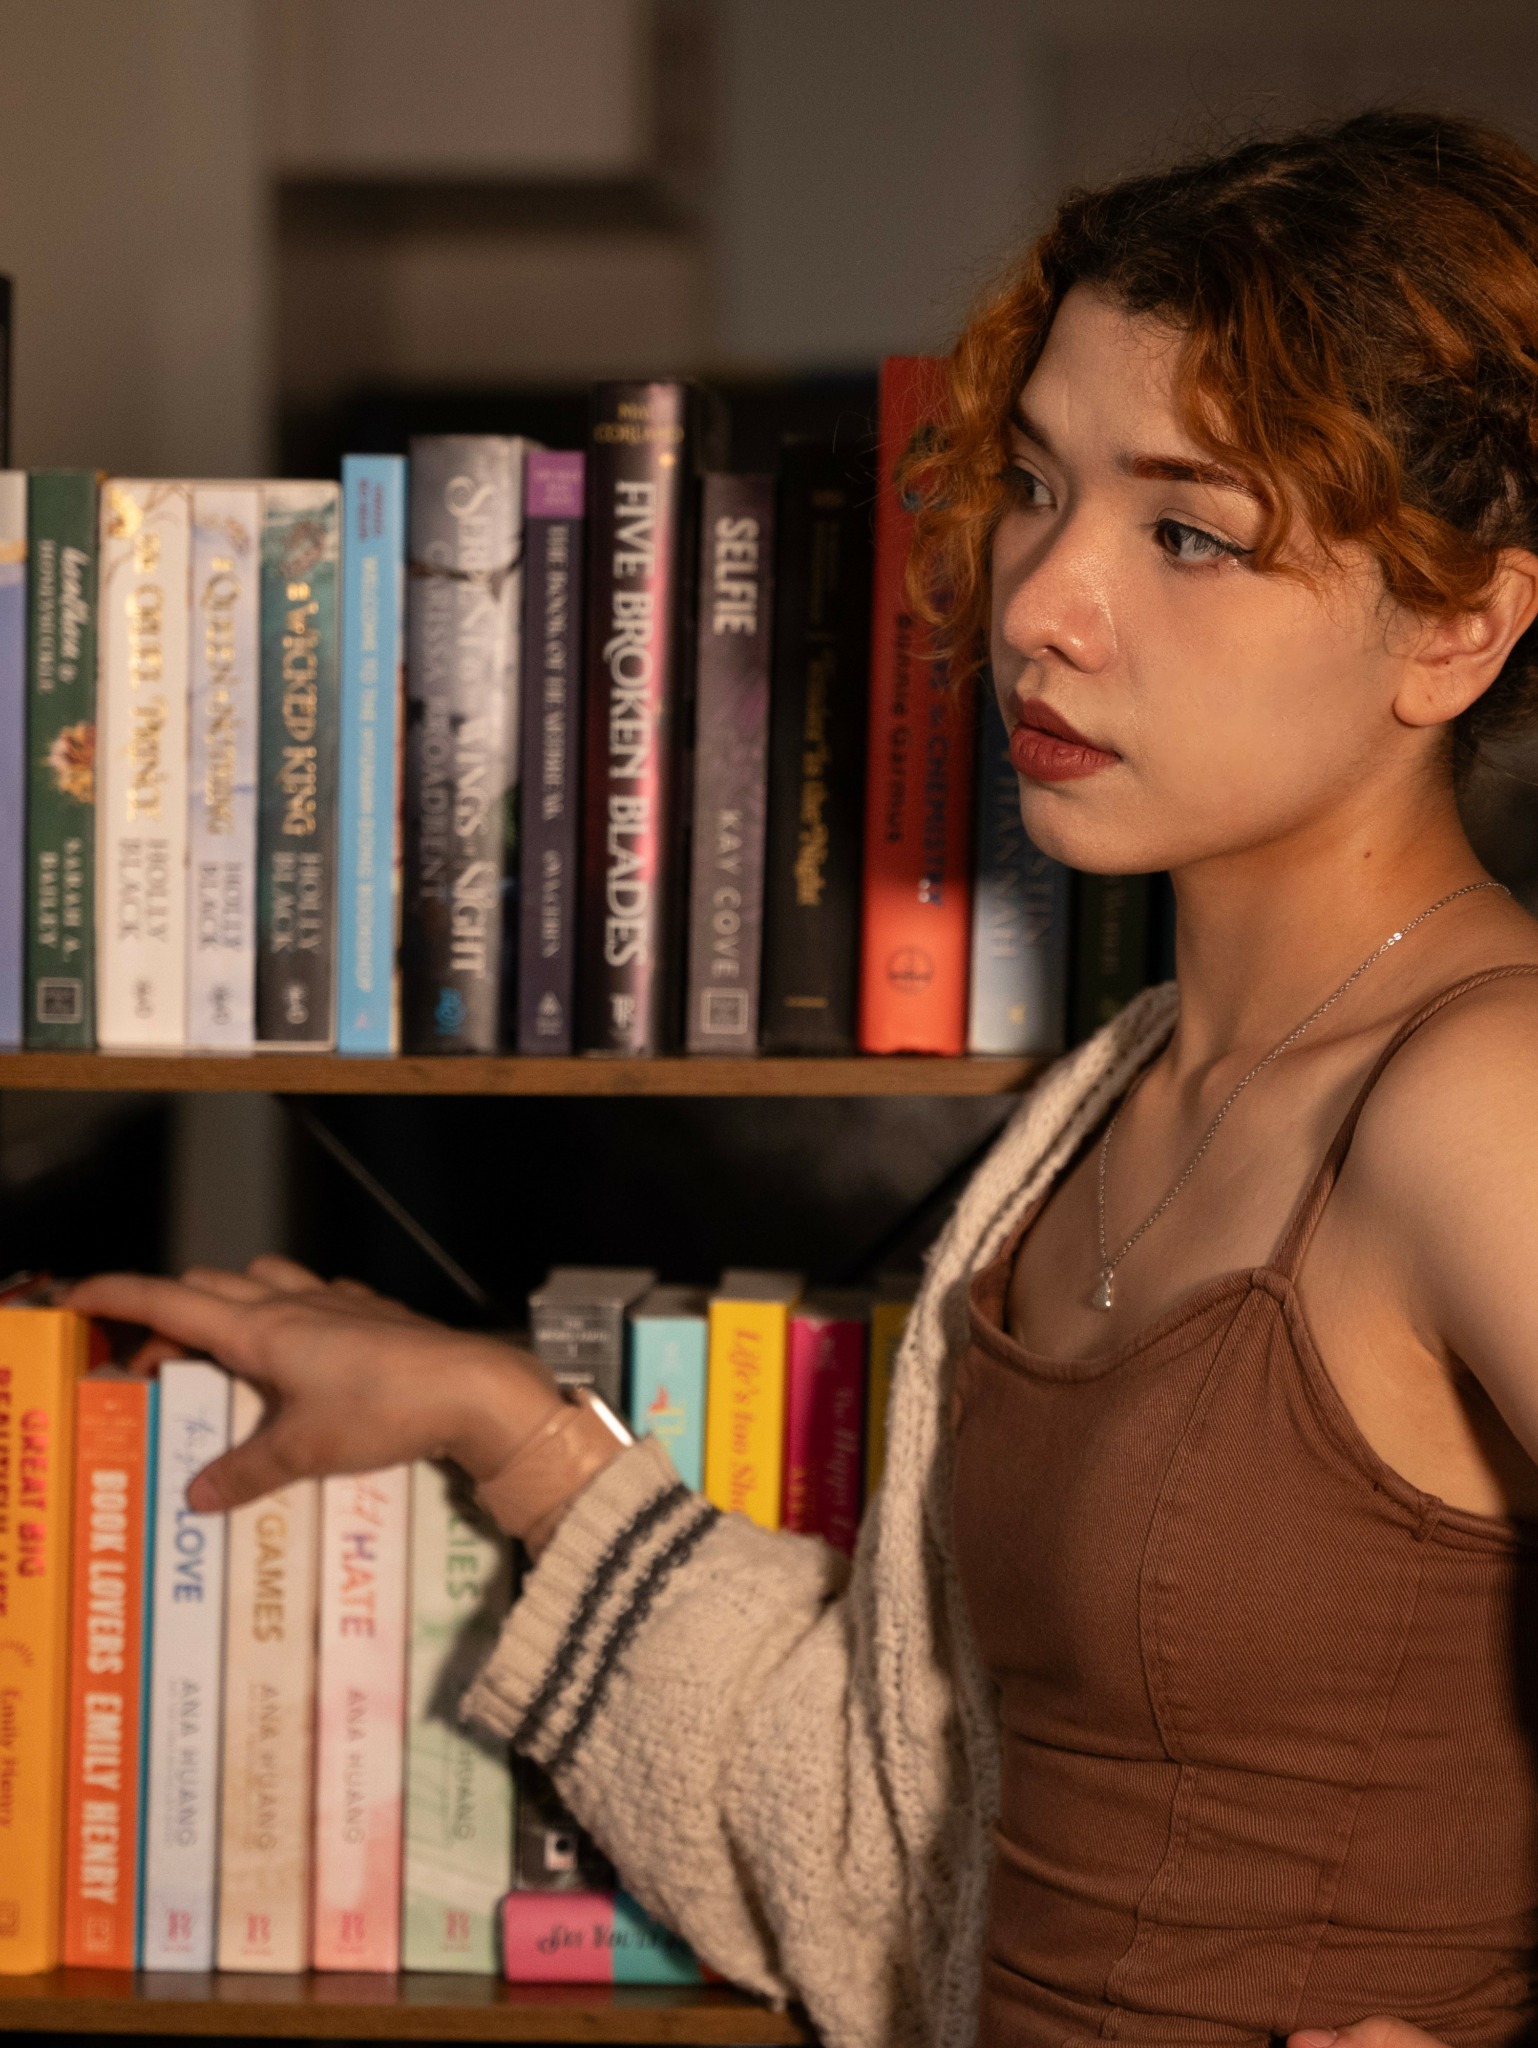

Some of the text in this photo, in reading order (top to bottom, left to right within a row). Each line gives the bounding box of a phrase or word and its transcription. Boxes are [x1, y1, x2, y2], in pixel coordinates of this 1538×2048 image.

[613, 481, 658, 580] FIVE
[712, 516, 761, 636] SELFIE
[281, 600, 321, 742] WICKED
[603, 590, 655, 779] BROKEN
[884, 614, 915, 843] Bonnie Garmus
[276, 745, 318, 837] KING
[37, 851, 60, 949] BAILEY
[62, 837, 84, 927] SARAH
[118, 838, 143, 942] BLACK
[145, 838, 170, 944] HOLLY
[198, 861, 220, 952] BLACK
[221, 861, 244, 952] HOLLY
[270, 852, 298, 955] BLACK
[297, 852, 324, 955] HOLLY
[449, 861, 500, 980] NIGHT
[604, 795, 652, 968] BLADES
[711, 807, 744, 979] KAY COVE
[990, 778, 1021, 959] HANNAH
[1024, 854, 1056, 949] STIN
[728, 1326, 763, 1405] Life's
[17, 1408, 49, 1578] GREAT BIG
[89, 1468, 130, 1552] BOOK
[173, 1508, 206, 1605] LOVE
[252, 1512, 289, 1644] GAMES
[339, 1531, 378, 1638] HATE
[86, 1560, 127, 1675] LOVERS
[79, 1692, 124, 1905] EMILY HENRY
[177, 1680, 201, 1848] ANA HUANG
[256, 1683, 281, 1852] ANA HUANG
[344, 1687, 367, 1845] ANA HUANG
